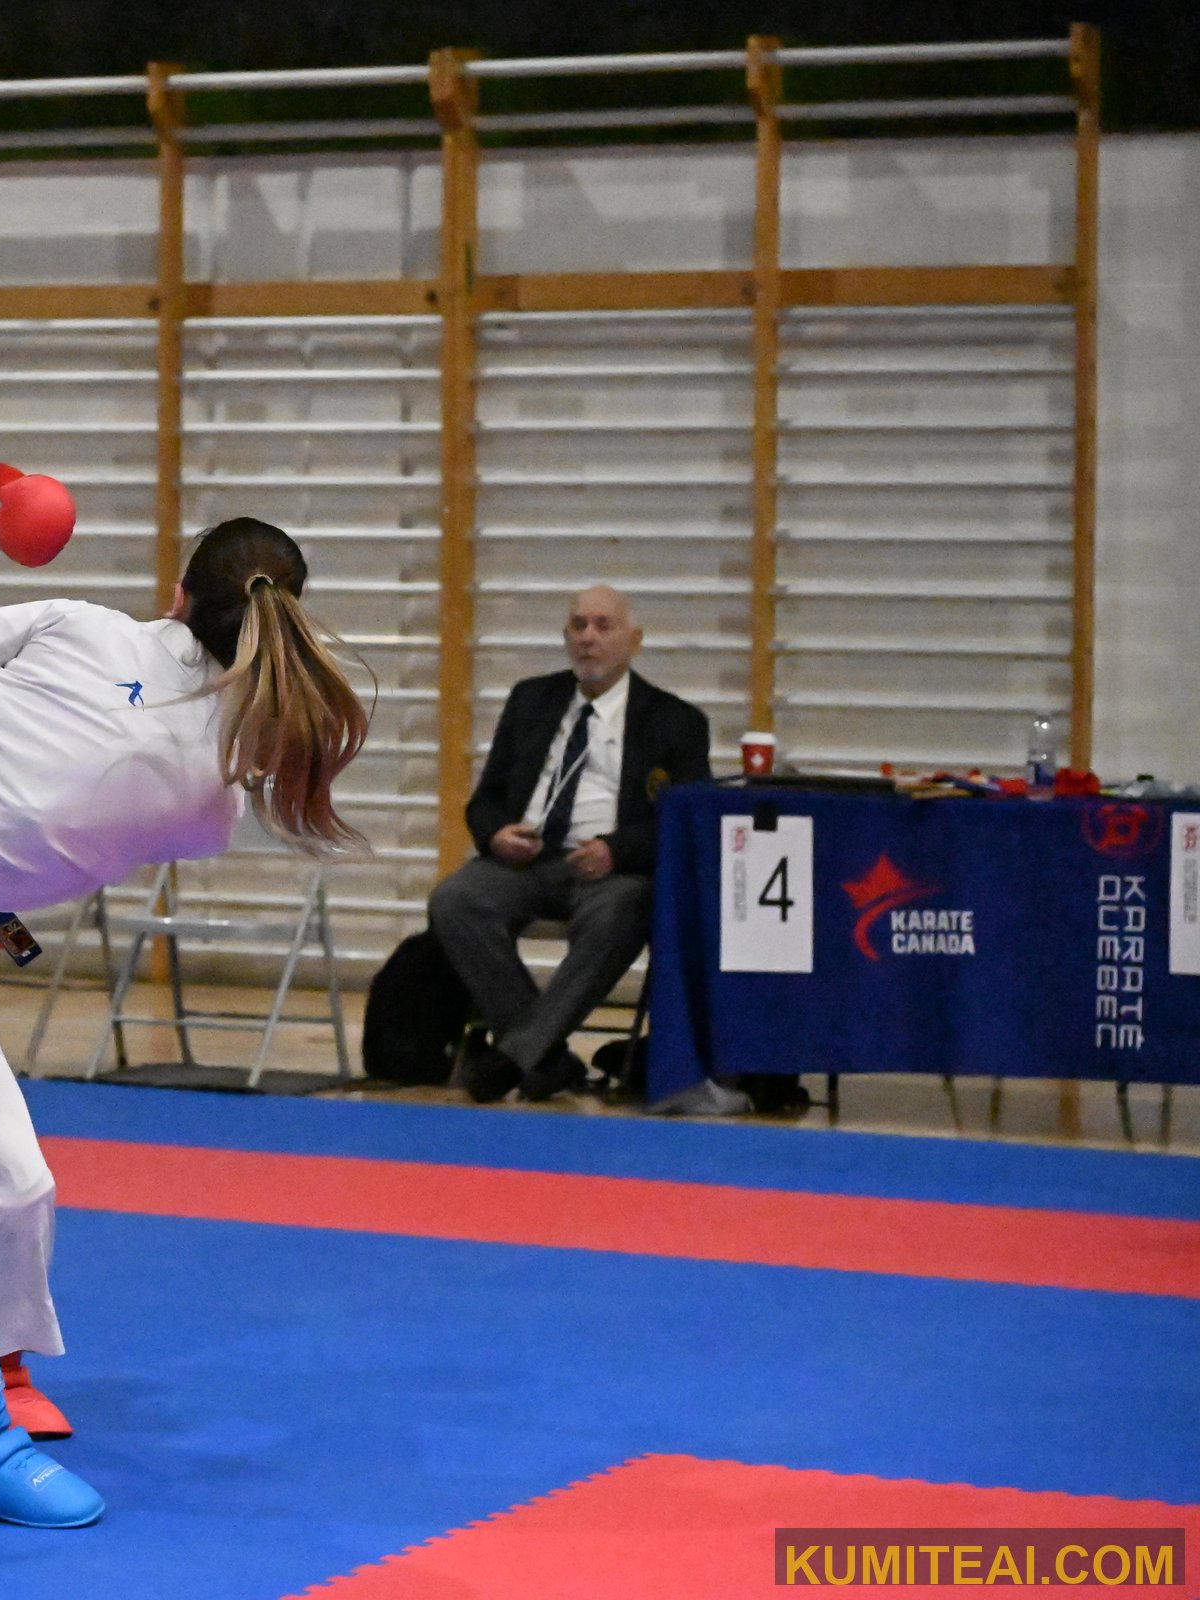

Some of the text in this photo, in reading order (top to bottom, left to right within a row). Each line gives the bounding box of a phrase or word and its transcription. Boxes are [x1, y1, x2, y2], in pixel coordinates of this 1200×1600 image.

[758, 856, 794, 922] 4
[891, 910, 974, 931] KARATE
[892, 933, 975, 954] CANADA
[1096, 875, 1121, 1049] QUÉBEC
[1119, 875, 1146, 1051] KARATÉ
